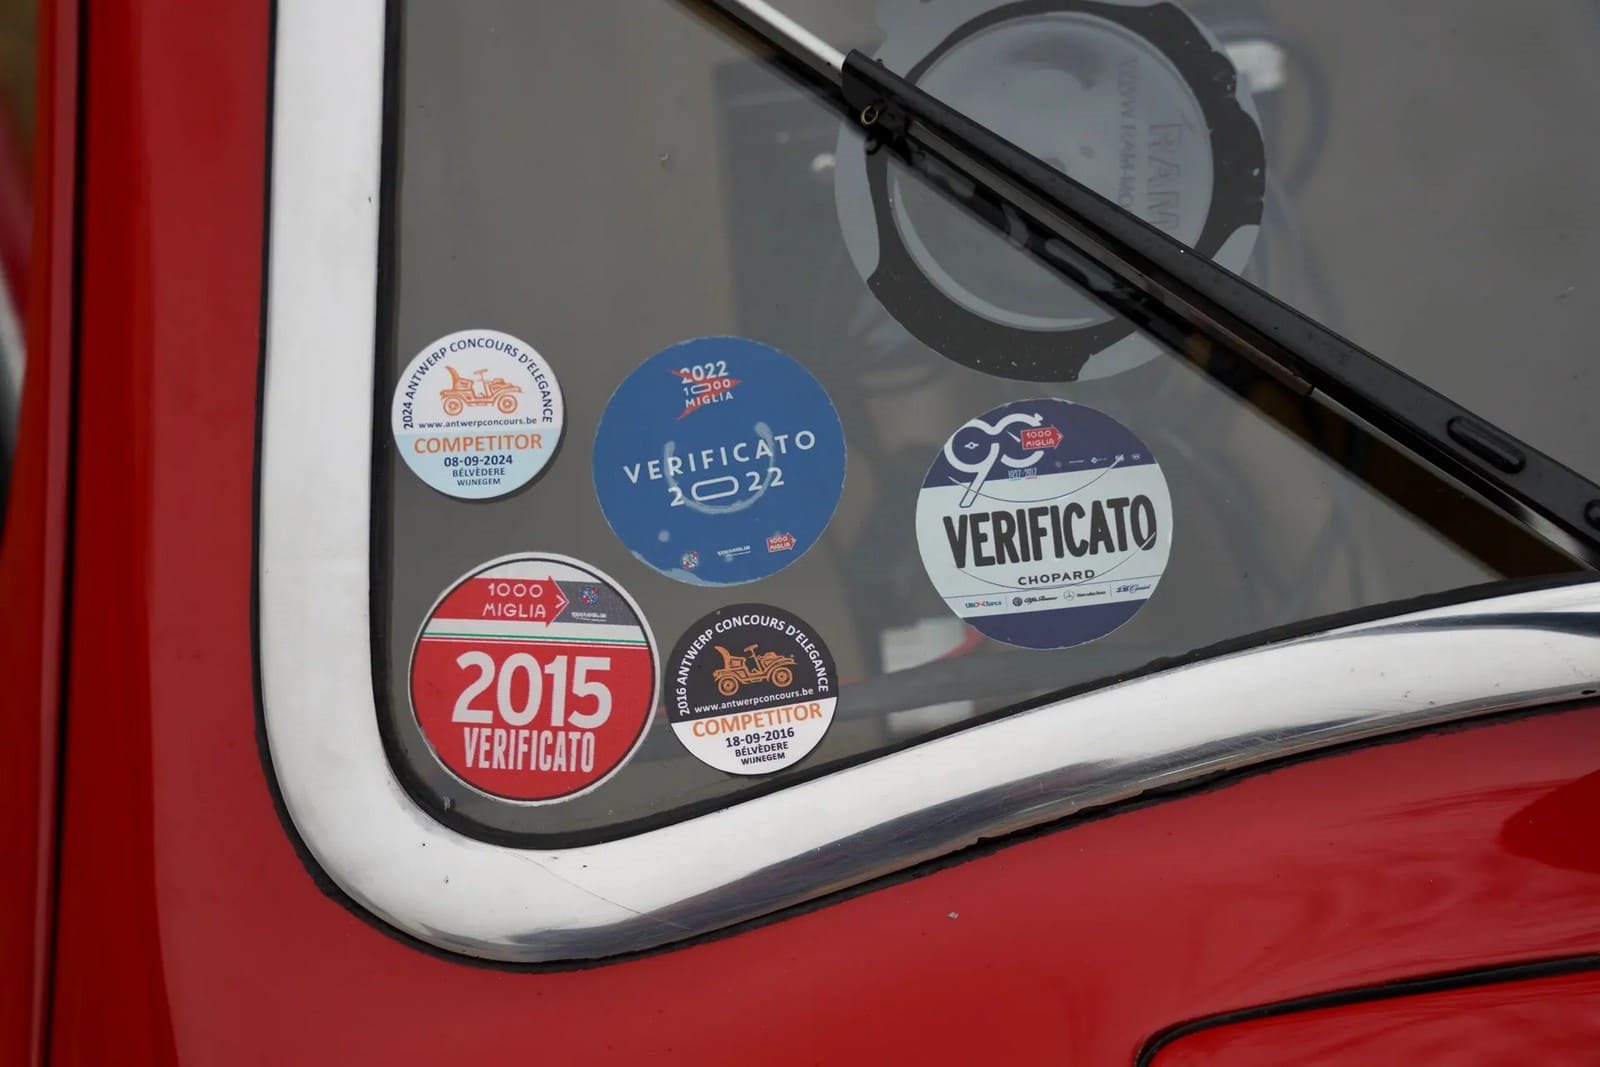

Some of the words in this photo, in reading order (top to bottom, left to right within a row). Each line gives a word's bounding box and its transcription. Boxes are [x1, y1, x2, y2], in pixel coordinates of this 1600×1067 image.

[449, 337, 519, 358] CONCOURS
[404, 347, 447, 400] ANTWERP
[680, 360, 729, 384] 2022
[518, 353, 554, 423] D'ELEGANCE
[685, 391, 734, 409] MIGLIA
[402, 401, 414, 429] 2024
[418, 416, 537, 430] www.antwerpconcours.be
[414, 433, 542, 454] COMPETITOR
[1025, 438, 1055, 449] MIGLIA
[1026, 430, 1052, 439] 1000
[444, 454, 513, 467] 08-09-2024
[623, 430, 816, 484] VERIFICATO
[457, 478, 501, 487] WIJNEGEM
[942, 494, 1157, 569] VERIFICATO
[1018, 569, 1096, 586] CHOPARD
[487, 583, 544, 598] 1000
[482, 603, 547, 619] MIGLIA
[715, 614, 786, 634] CONCOURS
[677, 629, 714, 686] ANTWERP
[785, 625, 829, 692] D'ELEGANCE
[451, 650, 613, 729] 2015
[675, 688, 690, 717] 2016
[694, 687, 814, 714] www.antwerpconcours.be
[692, 703, 823, 737] COMPETITOR
[725, 727, 795, 748] 18-09-2016
[463, 727, 596, 773] VERIFICATO
[735, 741, 789, 758] BÉLVÈDERE
[741, 752, 786, 766] WIJNEGEM
